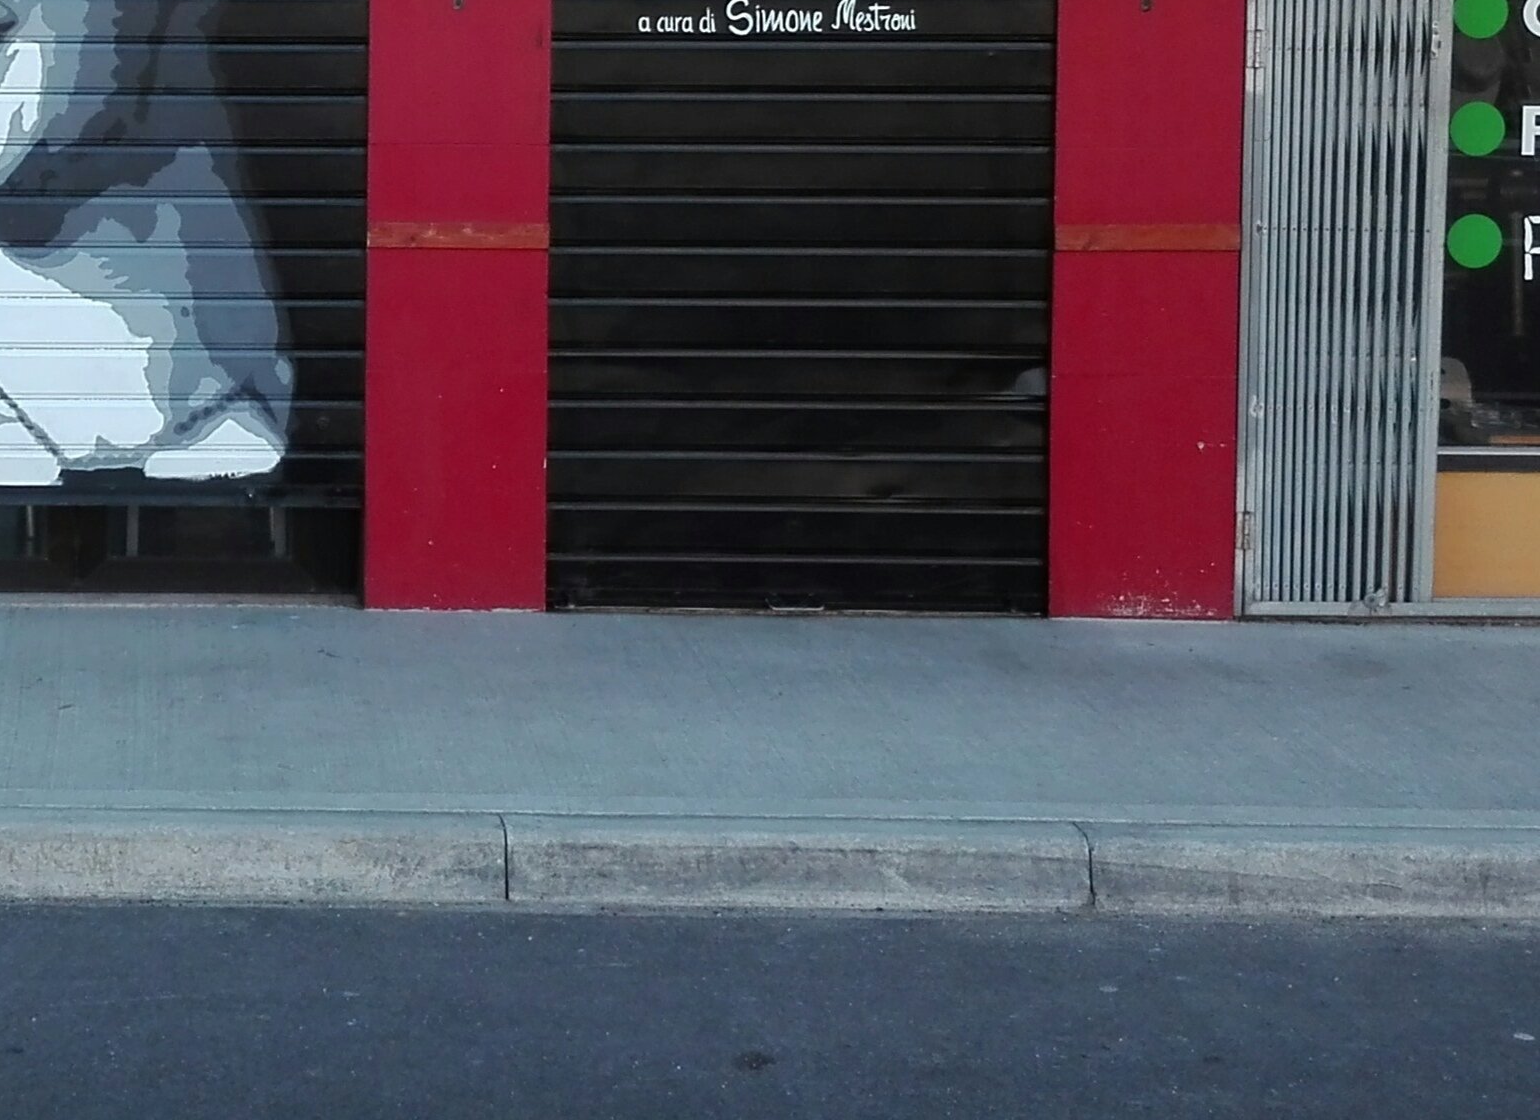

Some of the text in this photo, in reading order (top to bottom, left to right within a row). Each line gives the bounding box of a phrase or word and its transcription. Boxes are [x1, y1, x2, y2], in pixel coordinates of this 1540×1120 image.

[637, 15, 653, 33] a
[655, 15, 695, 34] cura
[698, 6, 718, 34] di
